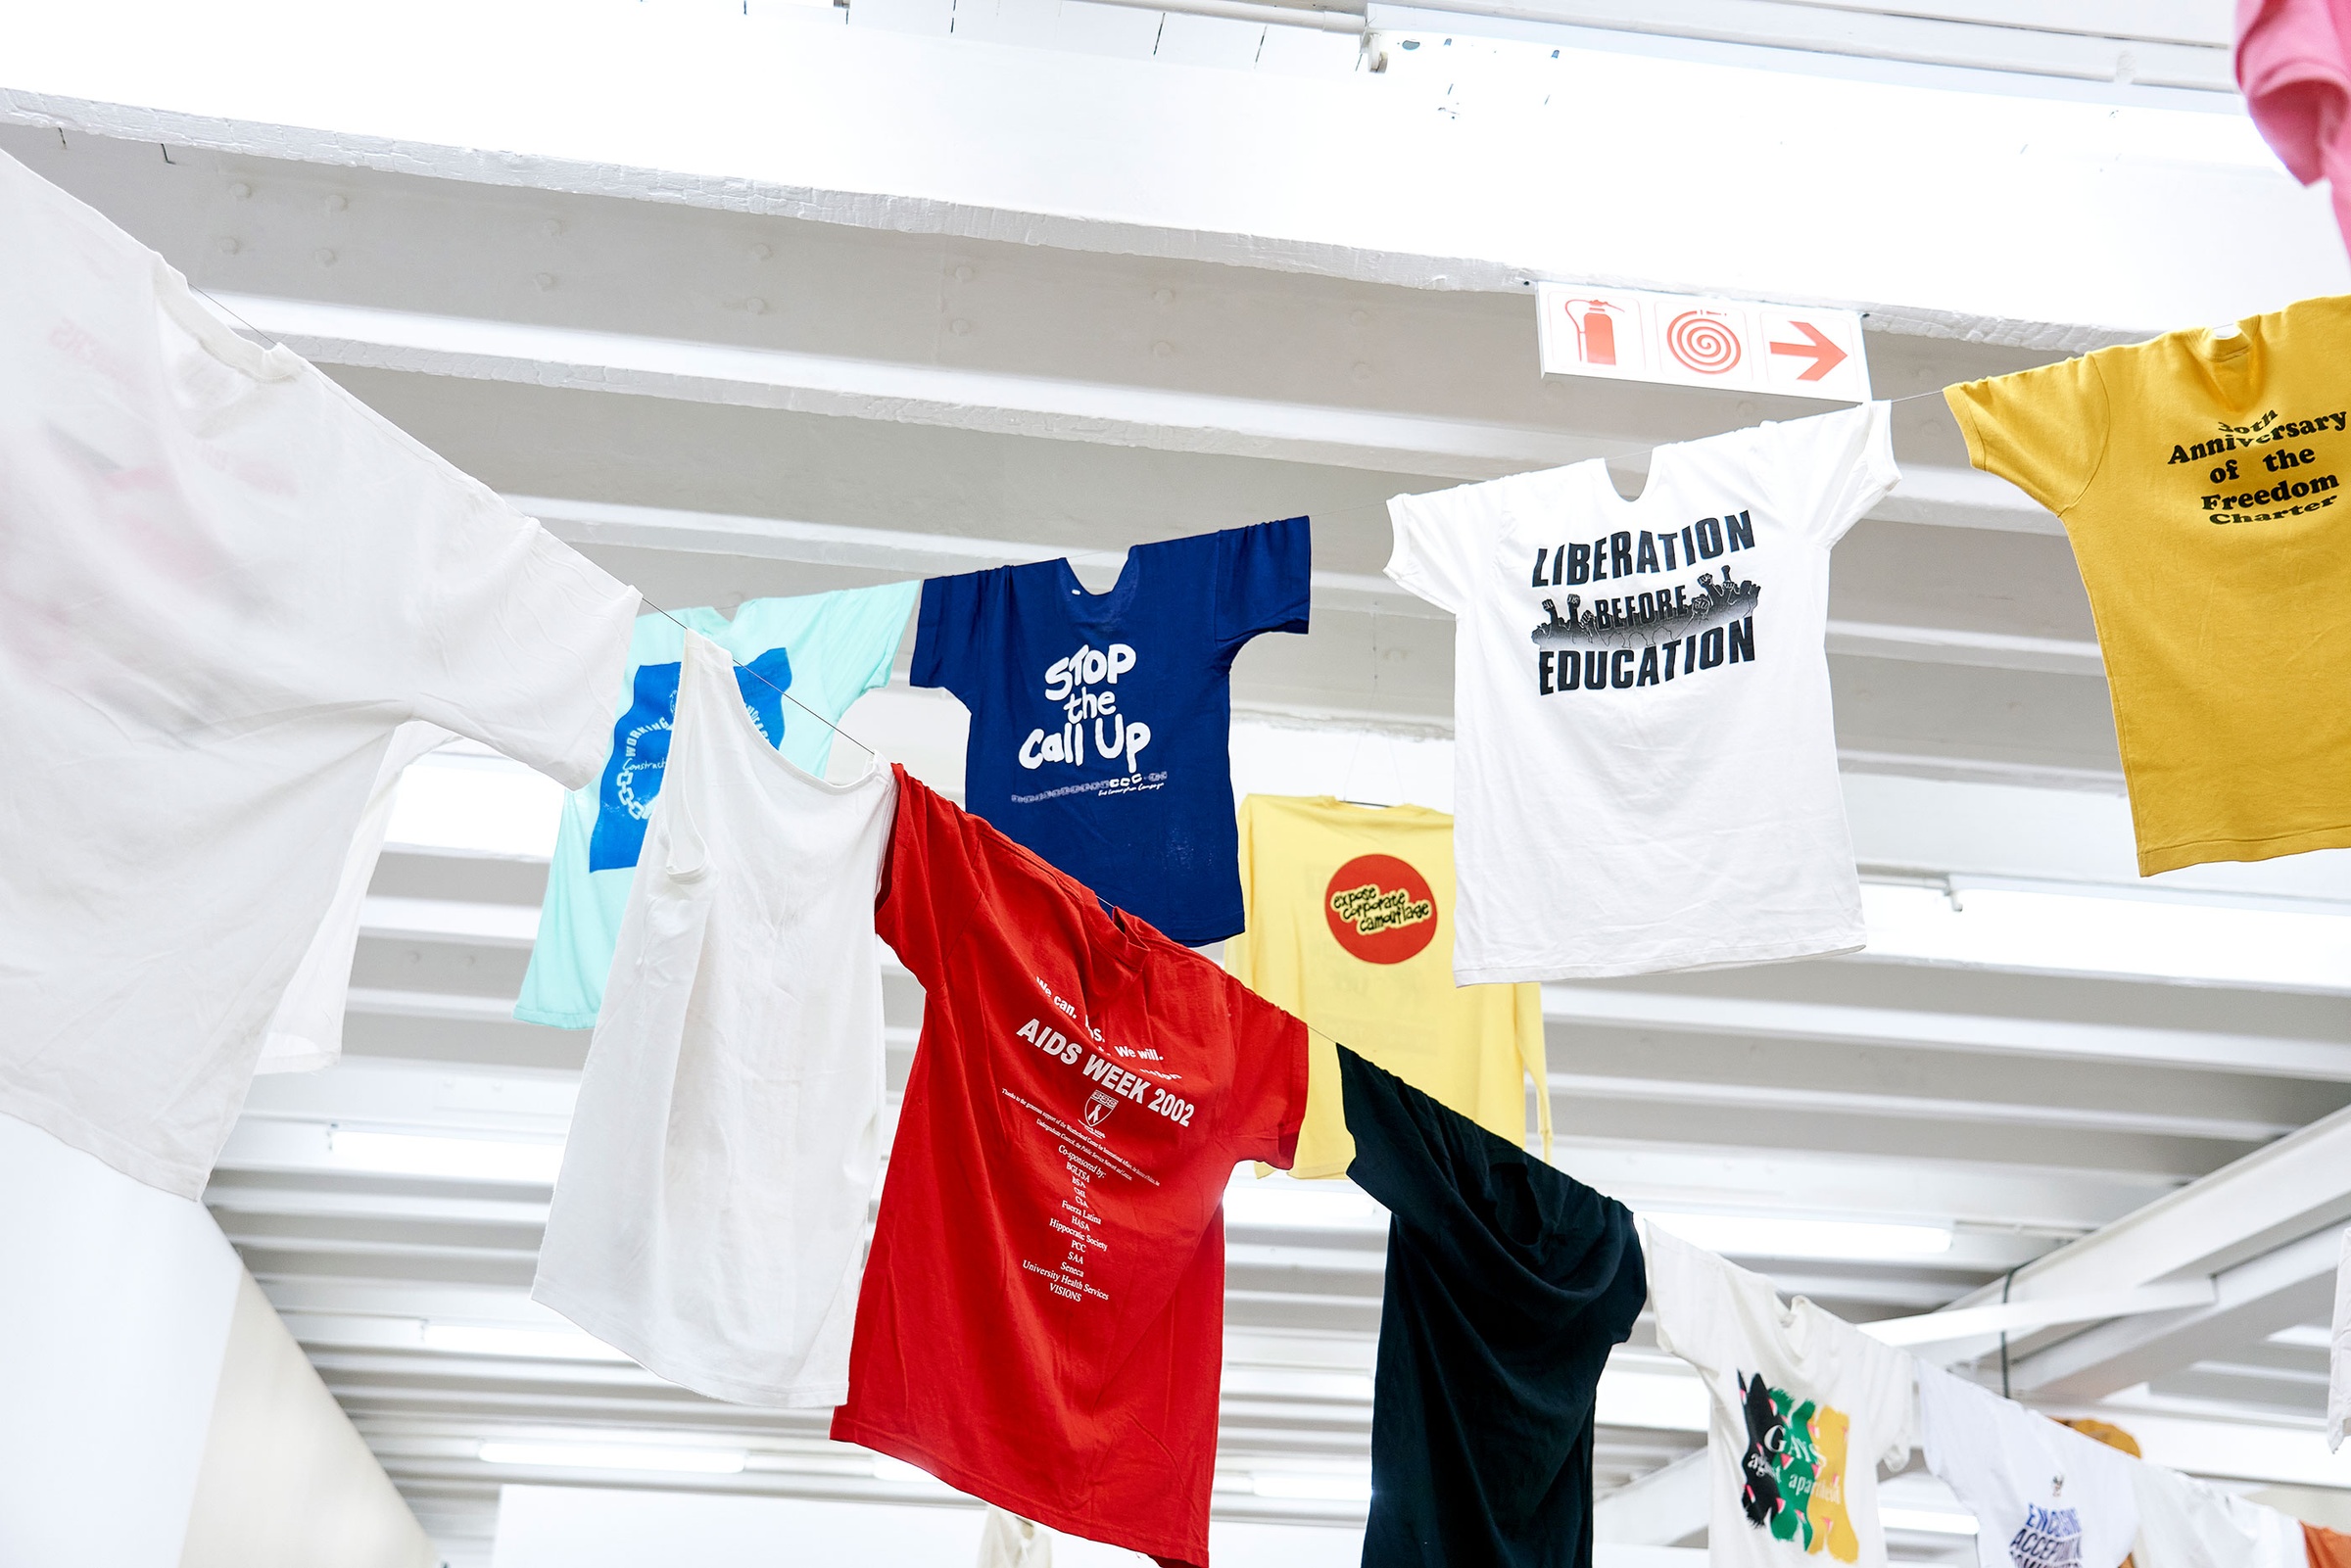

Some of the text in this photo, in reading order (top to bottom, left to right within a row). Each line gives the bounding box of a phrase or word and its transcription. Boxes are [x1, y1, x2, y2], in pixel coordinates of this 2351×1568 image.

[2167, 410, 2347, 465] Anniversary
[2218, 409, 2279, 434] 30th
[2209, 448, 2316, 484] of the
[2200, 473, 2340, 511] Freedom
[2209, 495, 2337, 525] Charter
[1532, 509, 1755, 588] LIBERATION
[1594, 585, 1689, 630] BEFORE
[1044, 642, 1137, 701] STOP
[1539, 616, 1755, 696] EDUCATION
[1063, 686, 1116, 724] the
[625, 716, 670, 757] WORKING
[1018, 722, 1083, 770] Call
[1333, 886, 1377, 909] expose
[1342, 891, 1407, 920] corporate
[1360, 902, 1429, 932] camouflage
[1053, 995, 1078, 1019] can.
[1114, 1045, 1137, 1059] We
[1137, 1049, 1164, 1062] will.
[1016, 1018, 1082, 1067] AIDS
[1082, 1053, 1152, 1105] WEEK
[1147, 1087, 1195, 1127] 2002
[1002, 1088, 1016, 1099] Thanks
[1058, 1144, 1097, 1172] Co-sponsored
[1096, 1167, 1106, 1178] by:
[1066, 1162, 1090, 1183] BGLTSA
[1061, 1200, 1101, 1224] Fuerza Latina
[1049, 1217, 1108, 1252] Hippocratic Society
[1071, 1240, 1086, 1252] PCC
[1060, 1261, 1084, 1278] Seneca
[1067, 1251, 1083, 1264] SAA
[1023, 1259, 1110, 1301] University Health Services
[1049, 1282, 1082, 1303] VISIONS
[1763, 1424, 1827, 1467] GAYS
